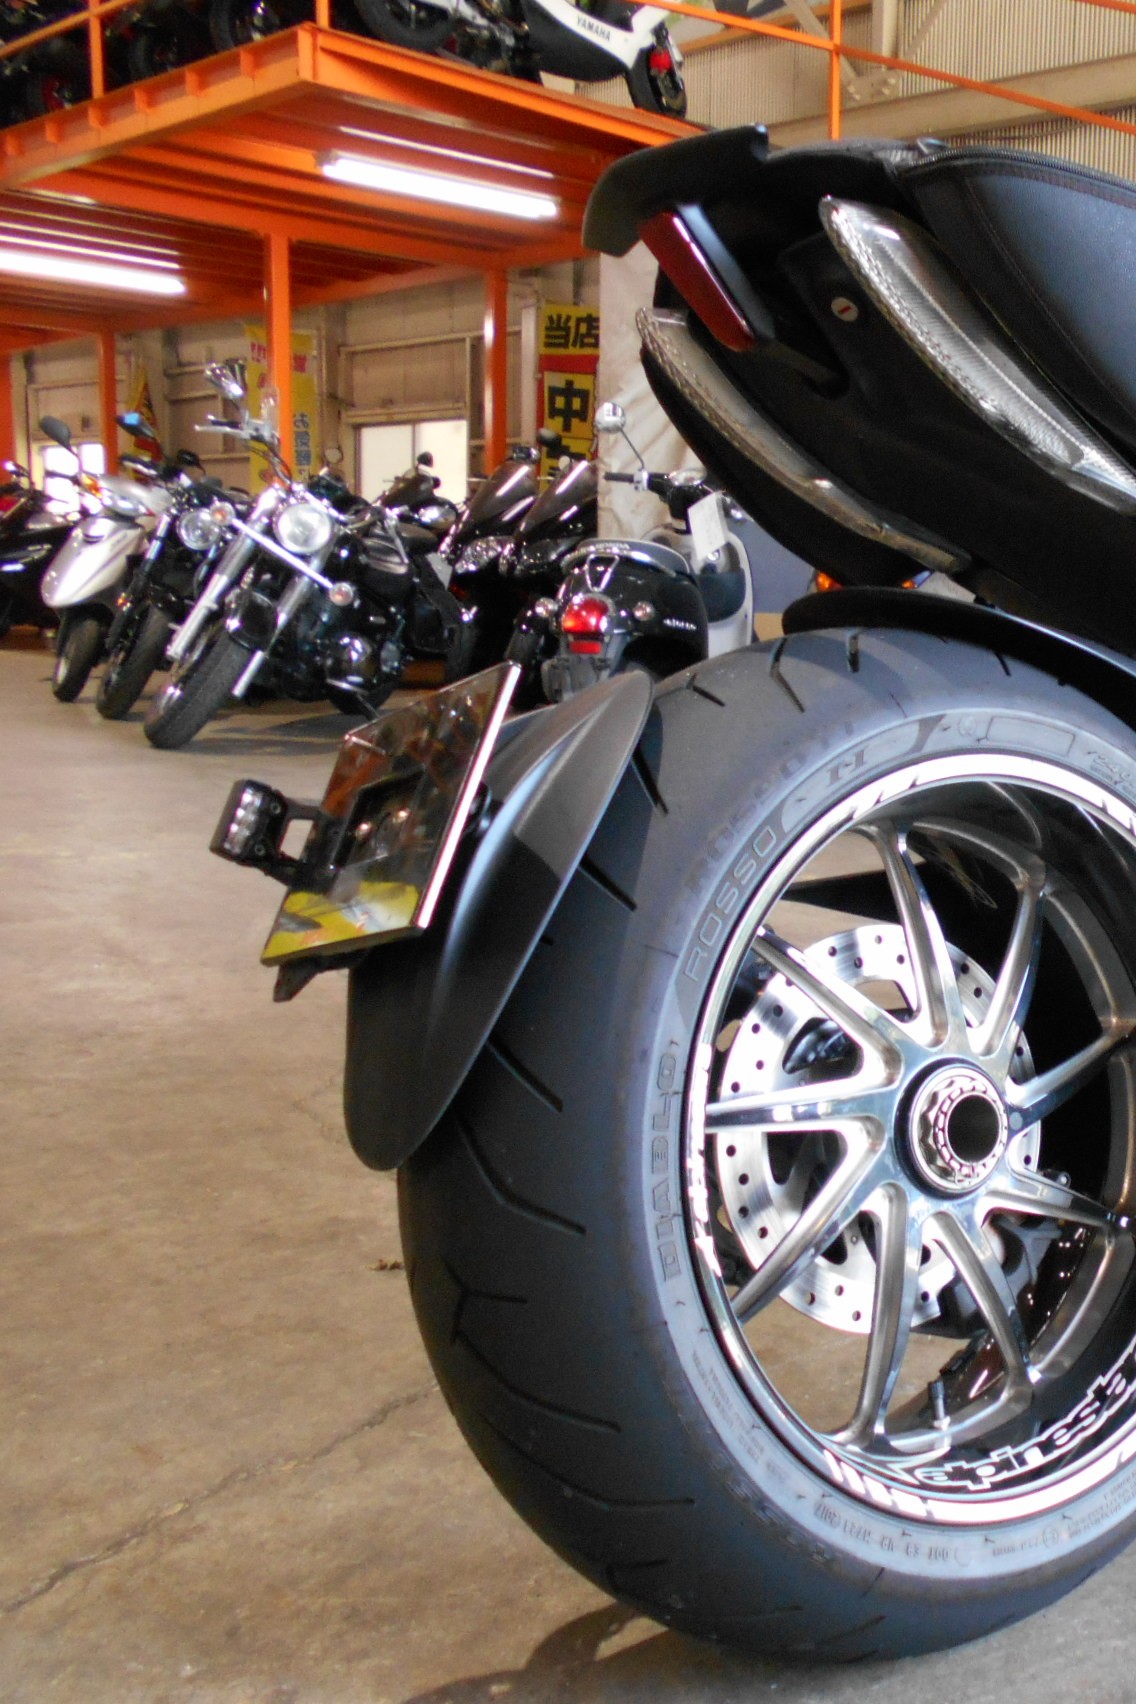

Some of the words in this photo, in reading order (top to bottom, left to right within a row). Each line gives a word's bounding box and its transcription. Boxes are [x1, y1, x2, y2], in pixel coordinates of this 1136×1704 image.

[577, 15, 611, 41] YAMAHA
[544, 313, 600, 349] 当店
[685, 825, 777, 982] ROSSO
[651, 1053, 682, 1282] DIABLO
